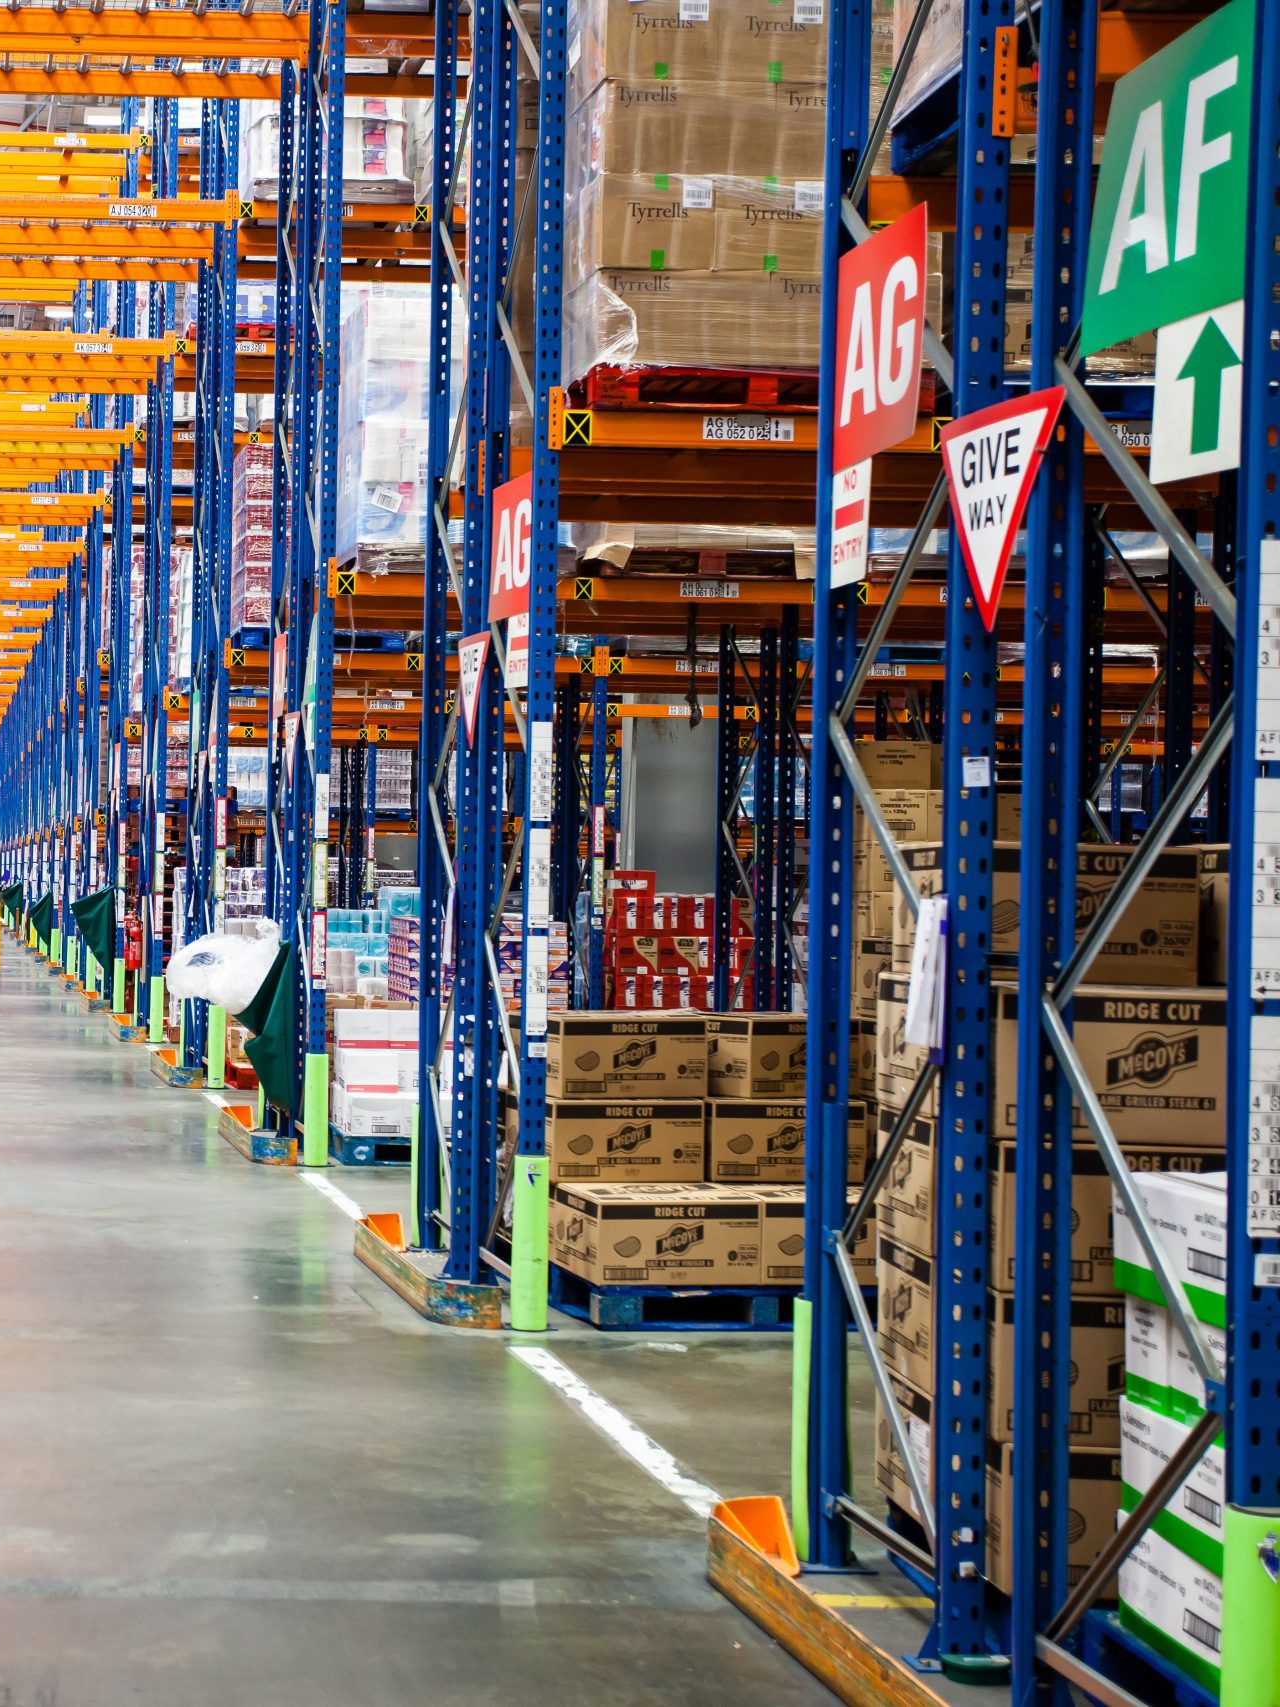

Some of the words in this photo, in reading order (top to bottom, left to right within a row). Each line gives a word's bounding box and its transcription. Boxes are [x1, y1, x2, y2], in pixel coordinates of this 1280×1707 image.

[632, 13, 693, 36] Tyrrells
[745, 16, 806, 37] Tyrrells
[616, 86, 677, 107] Tyrrells
[1098, 54, 1239, 296] AF
[111, 205, 122, 215] AJ
[628, 203, 688, 225] Tyrrells
[742, 204, 802, 226] Tyrrells
[609, 276, 669, 298] Tyrrells
[839, 255, 919, 429] AG
[706, 418, 723, 428] AG
[706, 428, 723, 438] AG
[727, 429, 745, 439] 052
[1121, 435, 1138, 446] 050
[961, 428, 1020, 489] GIVE
[843, 470, 857, 491] NO
[968, 494, 1008, 532] WAY
[493, 498, 531, 596] AG
[833, 535, 864, 565] ENTRY
[1262, 620, 1270, 633] 4
[1261, 651, 1269, 664] 3
[508, 659, 527, 673] ENTR
[1260, 733, 1275, 743] AF
[1257, 858, 1265, 871] 4
[1256, 890, 1264, 903] 3
[1255, 972, 1270, 982] AF
[1104, 1002, 1161, 1020] RIDGE
[1167, 1004, 1202, 1021] CUT
[612, 1023, 639, 1033] RIDGE
[642, 1024, 658, 1033] CUT
[1102, 1095, 1122, 1106] AME
[1124, 1095, 1166, 1108] GRILLED
[1168, 1098, 1199, 1109] STEAK
[1252, 1096, 1260, 1108] 4
[606, 1107, 632, 1117] RIDGE
[635, 1107, 653, 1117] CUT
[766, 1107, 793, 1117] RIDGE
[1252, 1128, 1260, 1141] 3
[1168, 1157, 1203, 1174] CUT
[1251, 1159, 1259, 1172] 2
[1251, 1191, 1259, 1204] 0
[655, 1207, 684, 1217] RIDGE
[687, 1207, 705, 1217] CUT
[1250, 1210, 1266, 1220] AF
